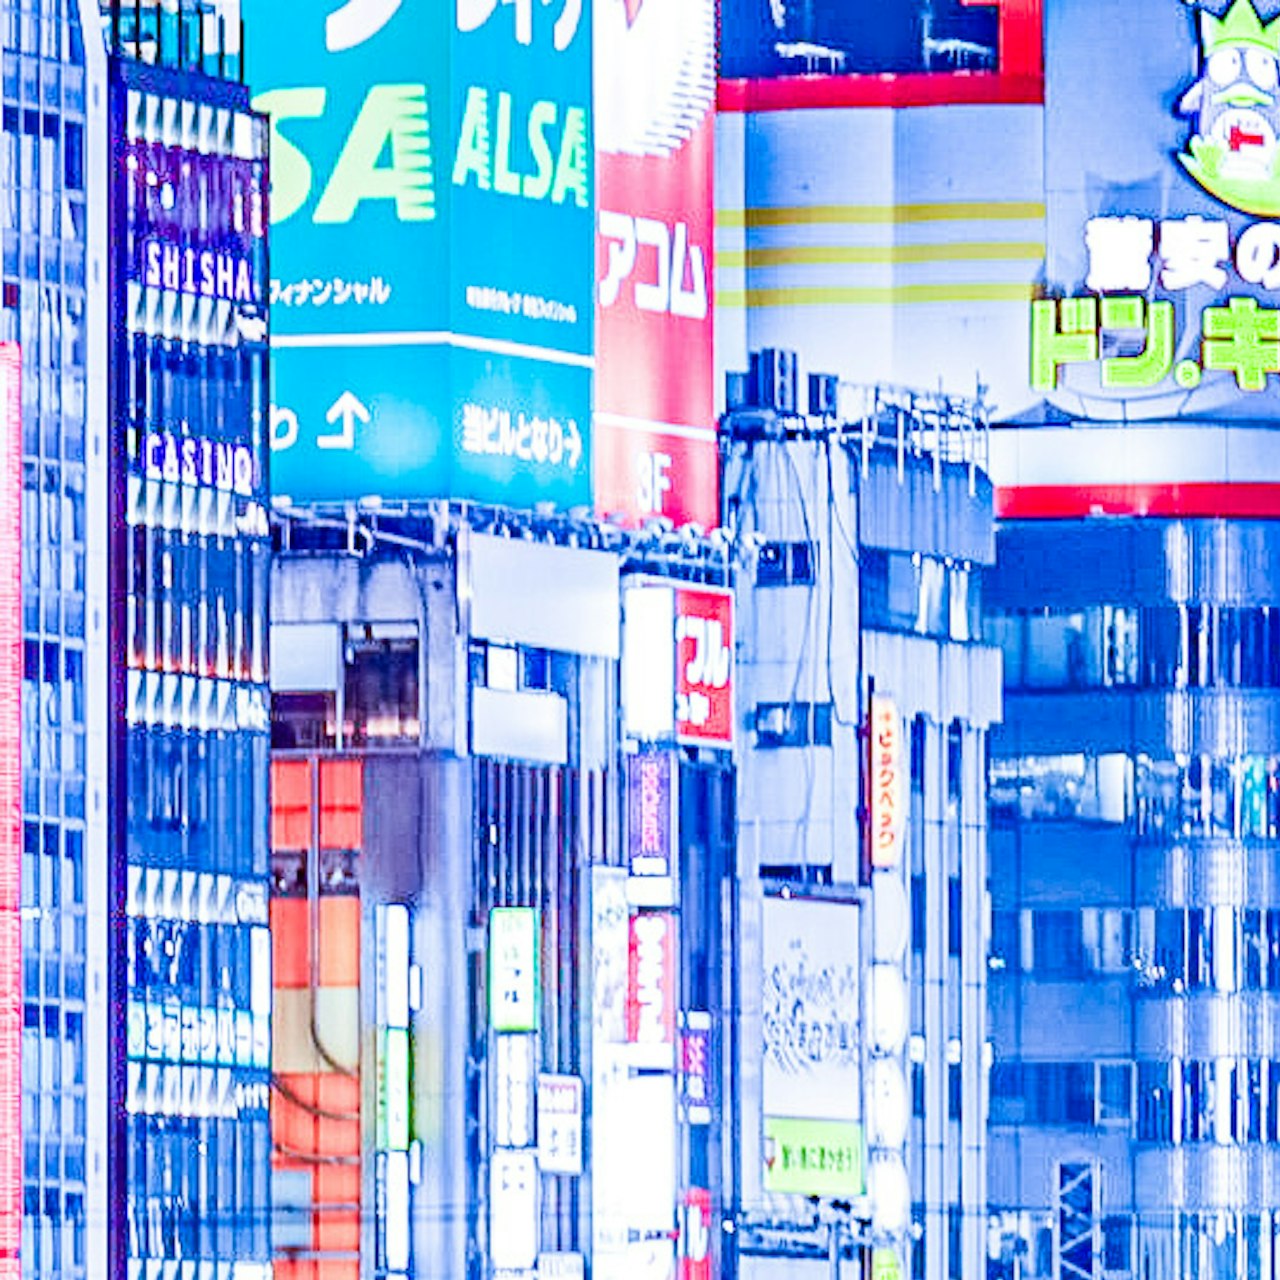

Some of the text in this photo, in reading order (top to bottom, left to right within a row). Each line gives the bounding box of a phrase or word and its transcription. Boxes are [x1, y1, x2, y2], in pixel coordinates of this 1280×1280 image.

[452, 86, 589, 208] ALSA
[146, 240, 251, 301] SHISHA
[599, 209, 708, 320] アコム
[146, 432, 252, 496] CASINO
